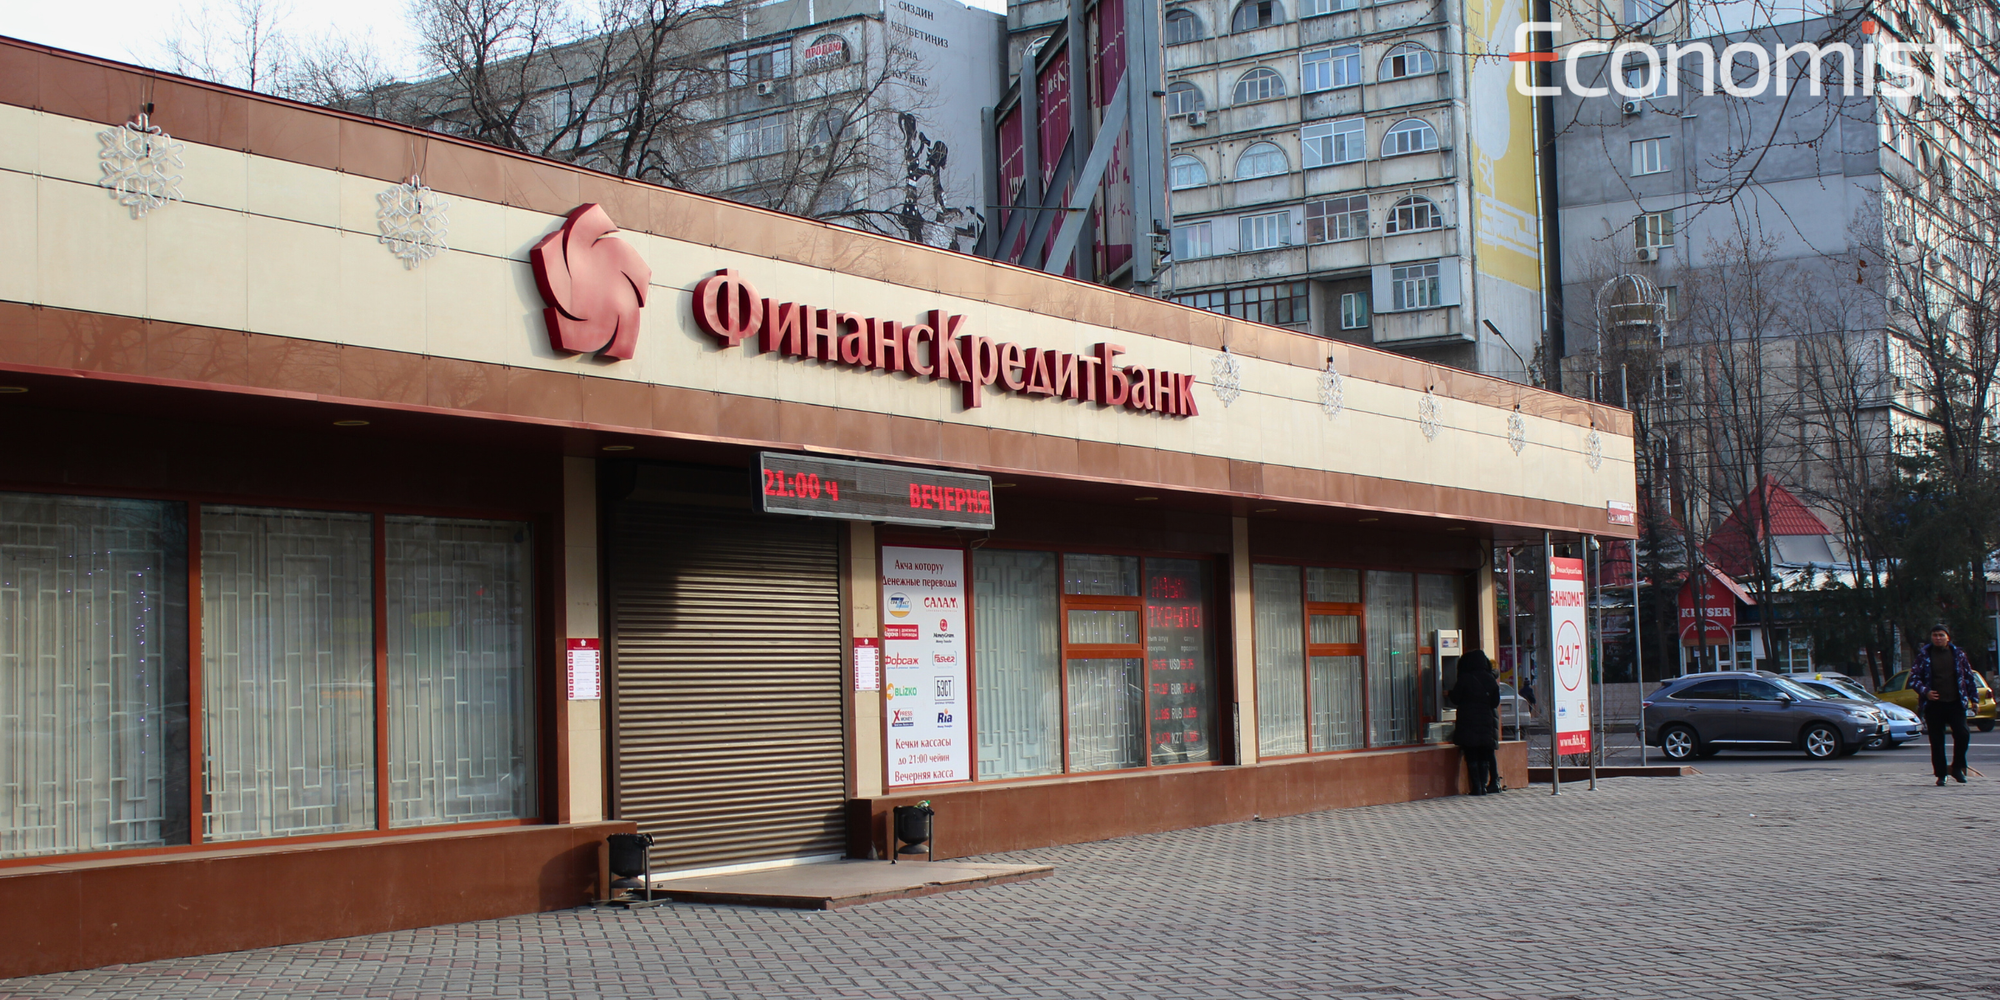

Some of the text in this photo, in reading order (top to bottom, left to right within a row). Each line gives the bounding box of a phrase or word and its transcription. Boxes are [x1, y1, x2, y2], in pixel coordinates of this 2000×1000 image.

[898, 1, 934, 21] СИЗДИН
[805, 41, 842, 59] ПРОДАЮ
[692, 268, 1199, 417] ФинансКредитБанк
[763, 468, 992, 515] 21:00 ч ВЕЧЕРНЯ
[895, 560, 945, 575] Акча которуу
[882, 575, 958, 590] Денежные переводы
[924, 597, 958, 608] САЛАМ
[1550, 590, 1585, 608] БАНКОМАТ
[1558, 643, 1580, 669] 24/7
[1169, 658, 1180, 670] USD
[936, 680, 951, 697] БЭСТ
[1170, 683, 1182, 695] EUR
[937, 708, 952, 723] Ria
[1171, 707, 1183, 720] RUB
[895, 738, 952, 750] Кечки кассасы
[1171, 732, 1183, 744] KZT
[897, 753, 950, 766] до 21:00 чейин
[894, 769, 954, 784] Вечерняя касса
